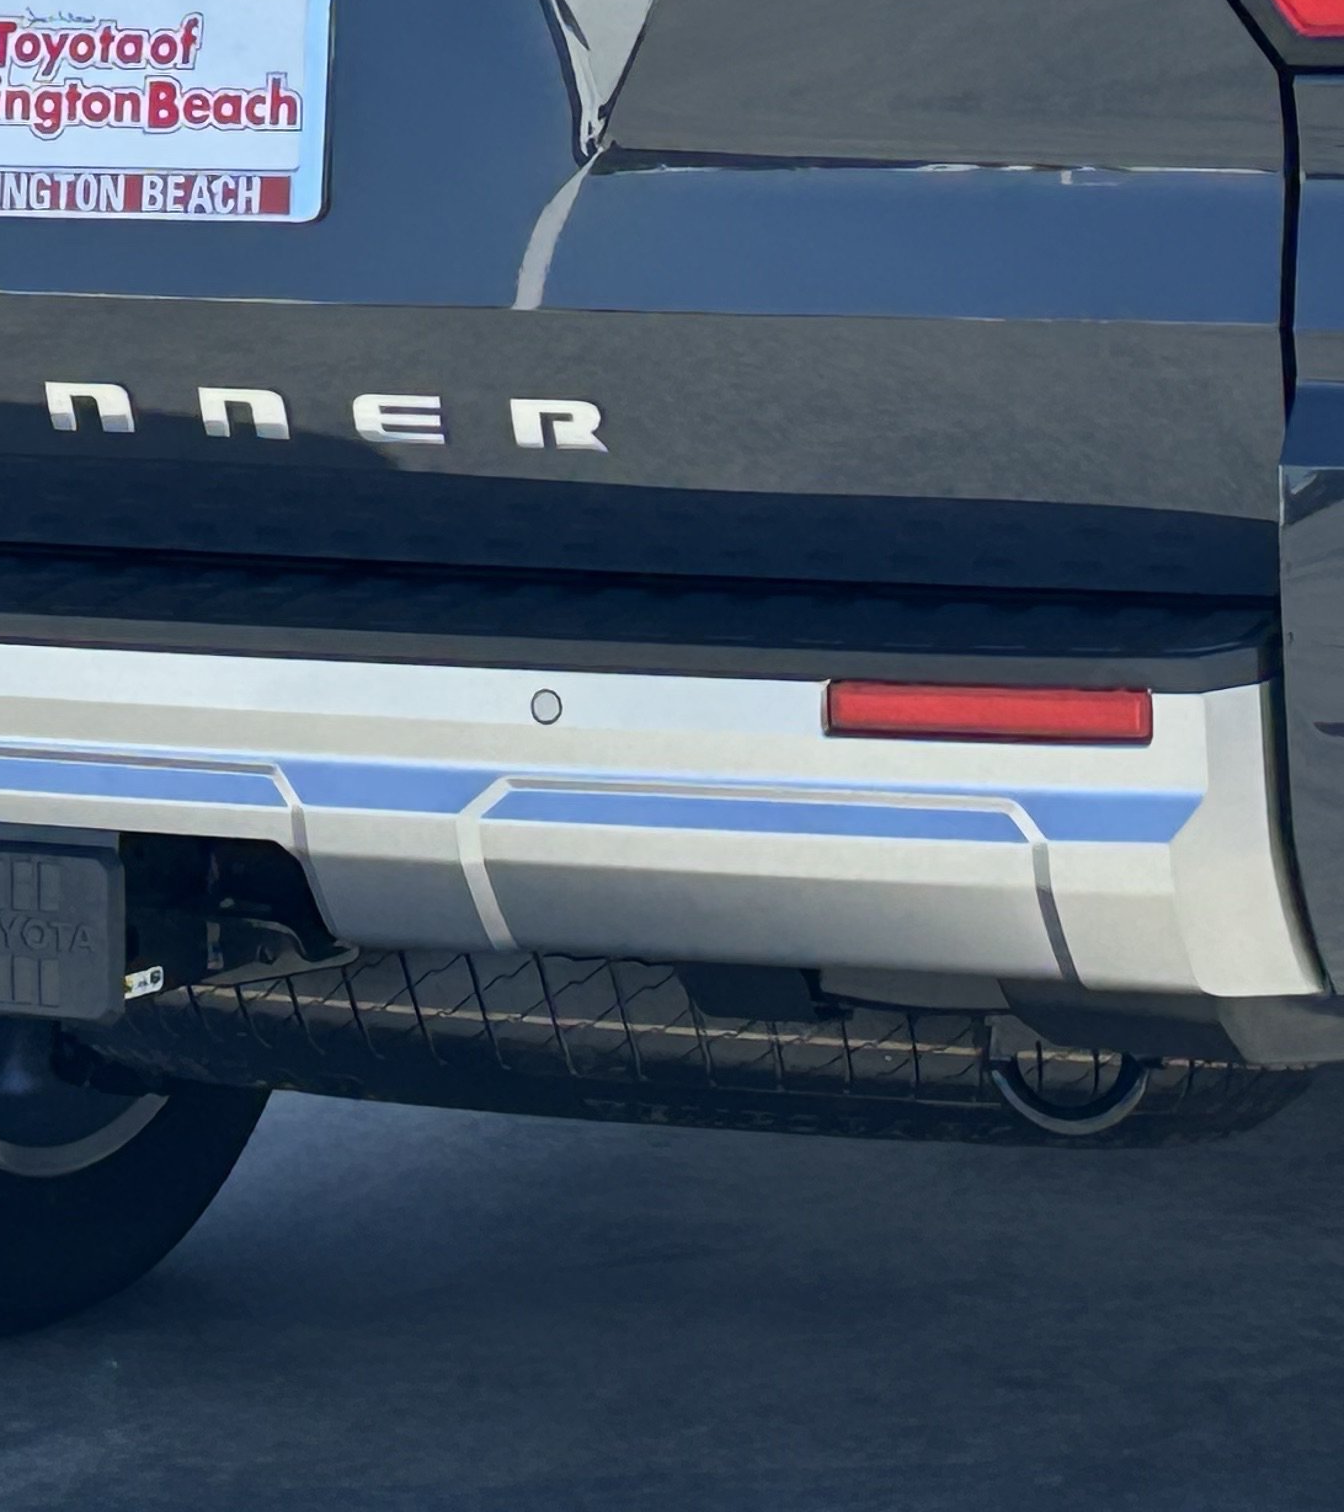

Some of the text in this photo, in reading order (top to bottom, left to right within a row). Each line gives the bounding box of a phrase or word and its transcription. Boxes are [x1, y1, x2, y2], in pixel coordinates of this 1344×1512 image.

[149, 16, 202, 65] of
[147, 77, 298, 129] Beach
[141, 174, 262, 214] BEACH
